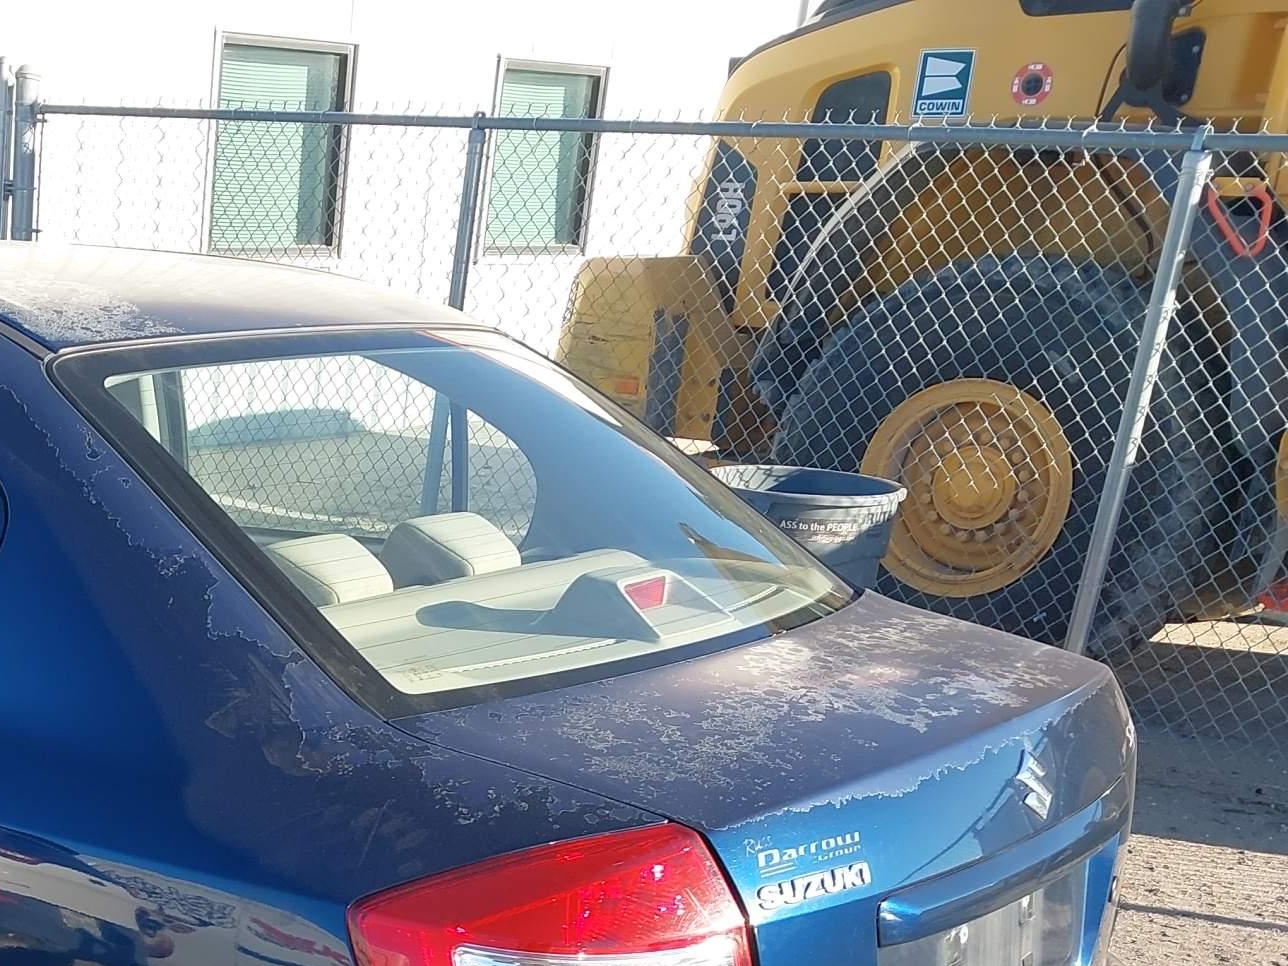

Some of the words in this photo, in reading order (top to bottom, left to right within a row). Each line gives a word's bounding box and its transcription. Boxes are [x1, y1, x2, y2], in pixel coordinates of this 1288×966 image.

[918, 101, 961, 112] COWIN
[798, 522, 809, 530] to
[810, 522, 825, 531] the
[826, 522, 857, 532] PEOPLE
[757, 831, 861, 867] Darrow
[757, 860, 872, 911] SUZUKI
